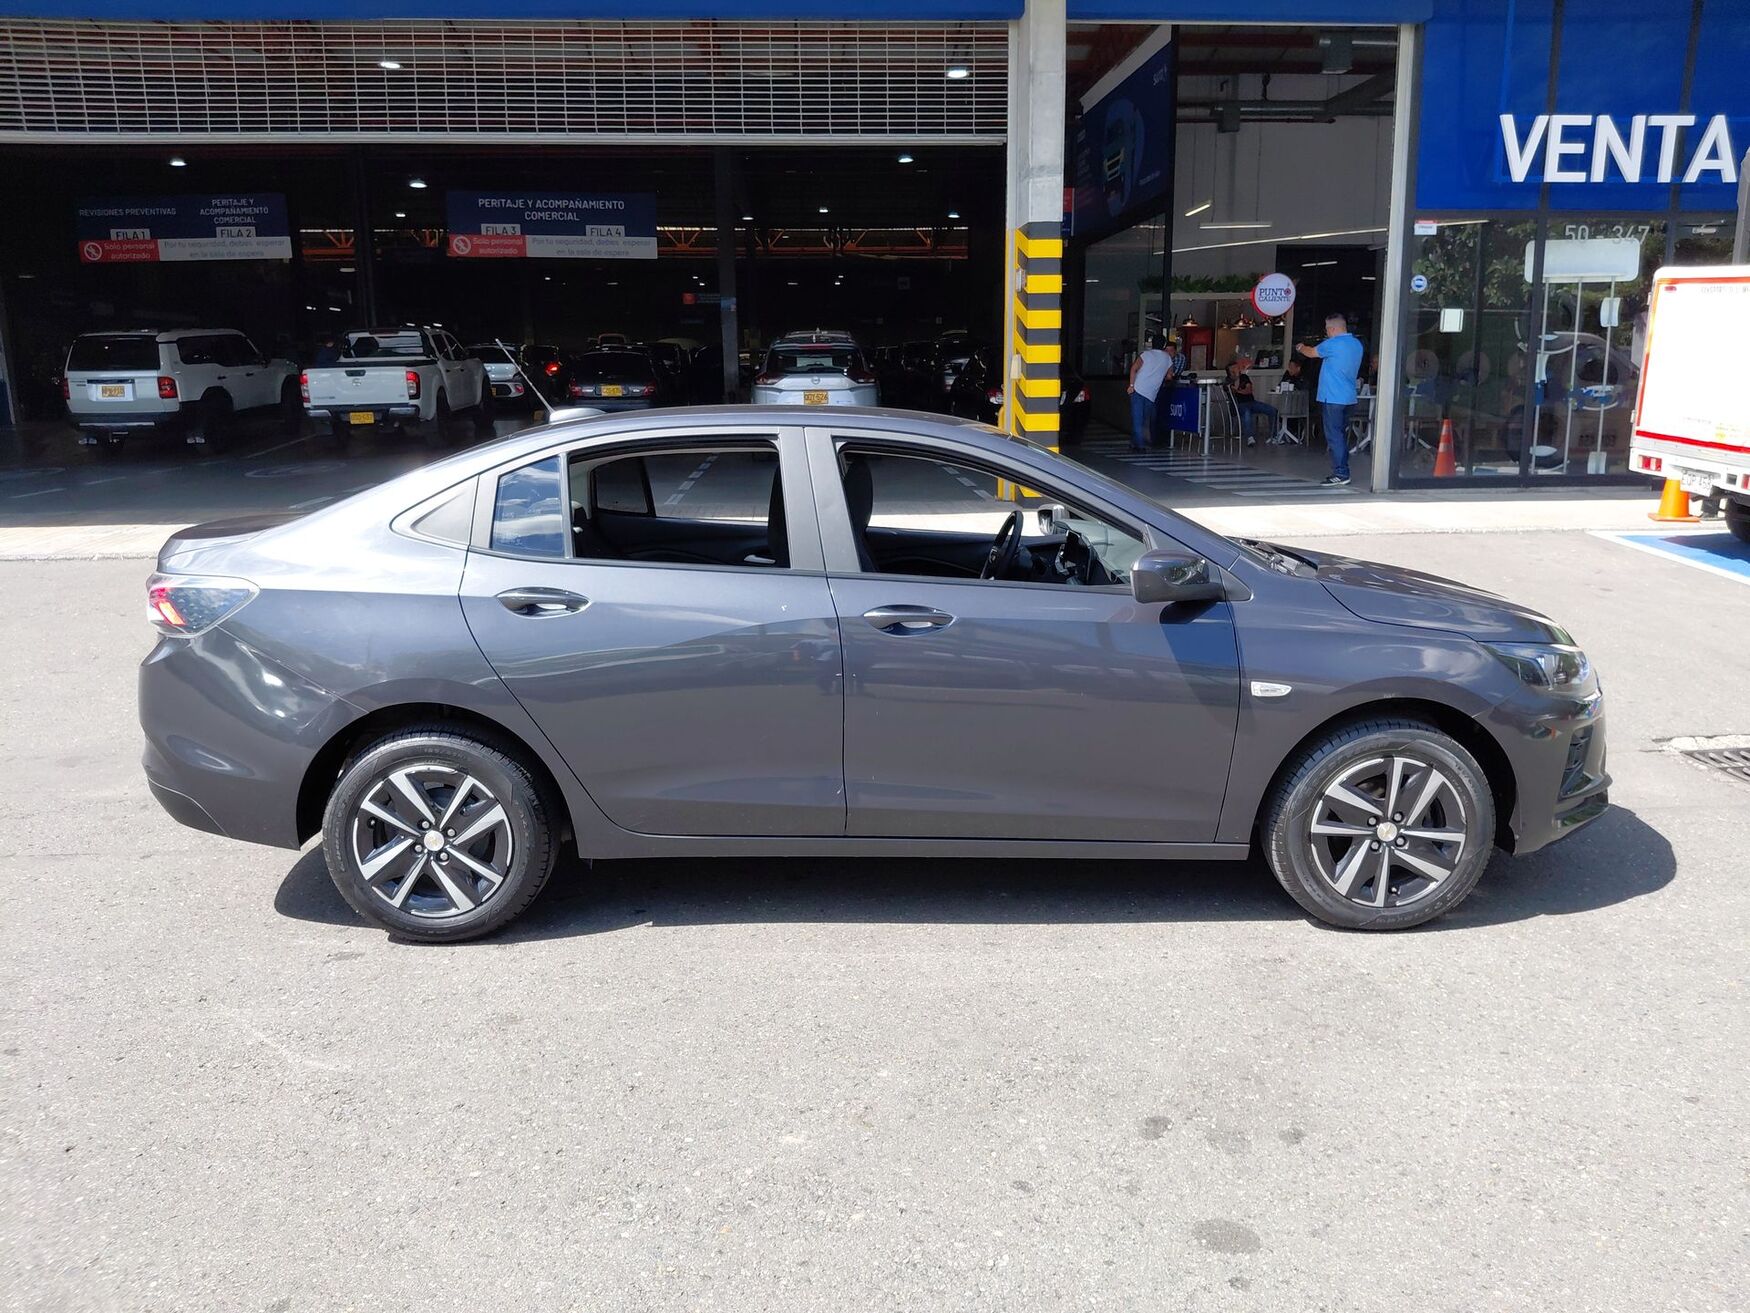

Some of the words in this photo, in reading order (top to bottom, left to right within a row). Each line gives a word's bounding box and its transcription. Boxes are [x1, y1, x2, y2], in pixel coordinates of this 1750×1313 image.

[1500, 114, 1737, 183] VENTA
[212, 199, 249, 207] PERITAJE
[478, 199, 525, 208] PERITAJE
[527, 199, 533, 208] Y
[535, 198, 625, 210] ACOMPAÑAMIENTO
[214, 216, 256, 225] COMERCIAL
[524, 211, 580, 221] COMERCIAL
[220, 229, 244, 238] FILA
[486, 226, 509, 235] FILA
[590, 228, 613, 237] FILA
[116, 231, 139, 240] FILA
[1260, 287, 1292, 297] PUNTO
